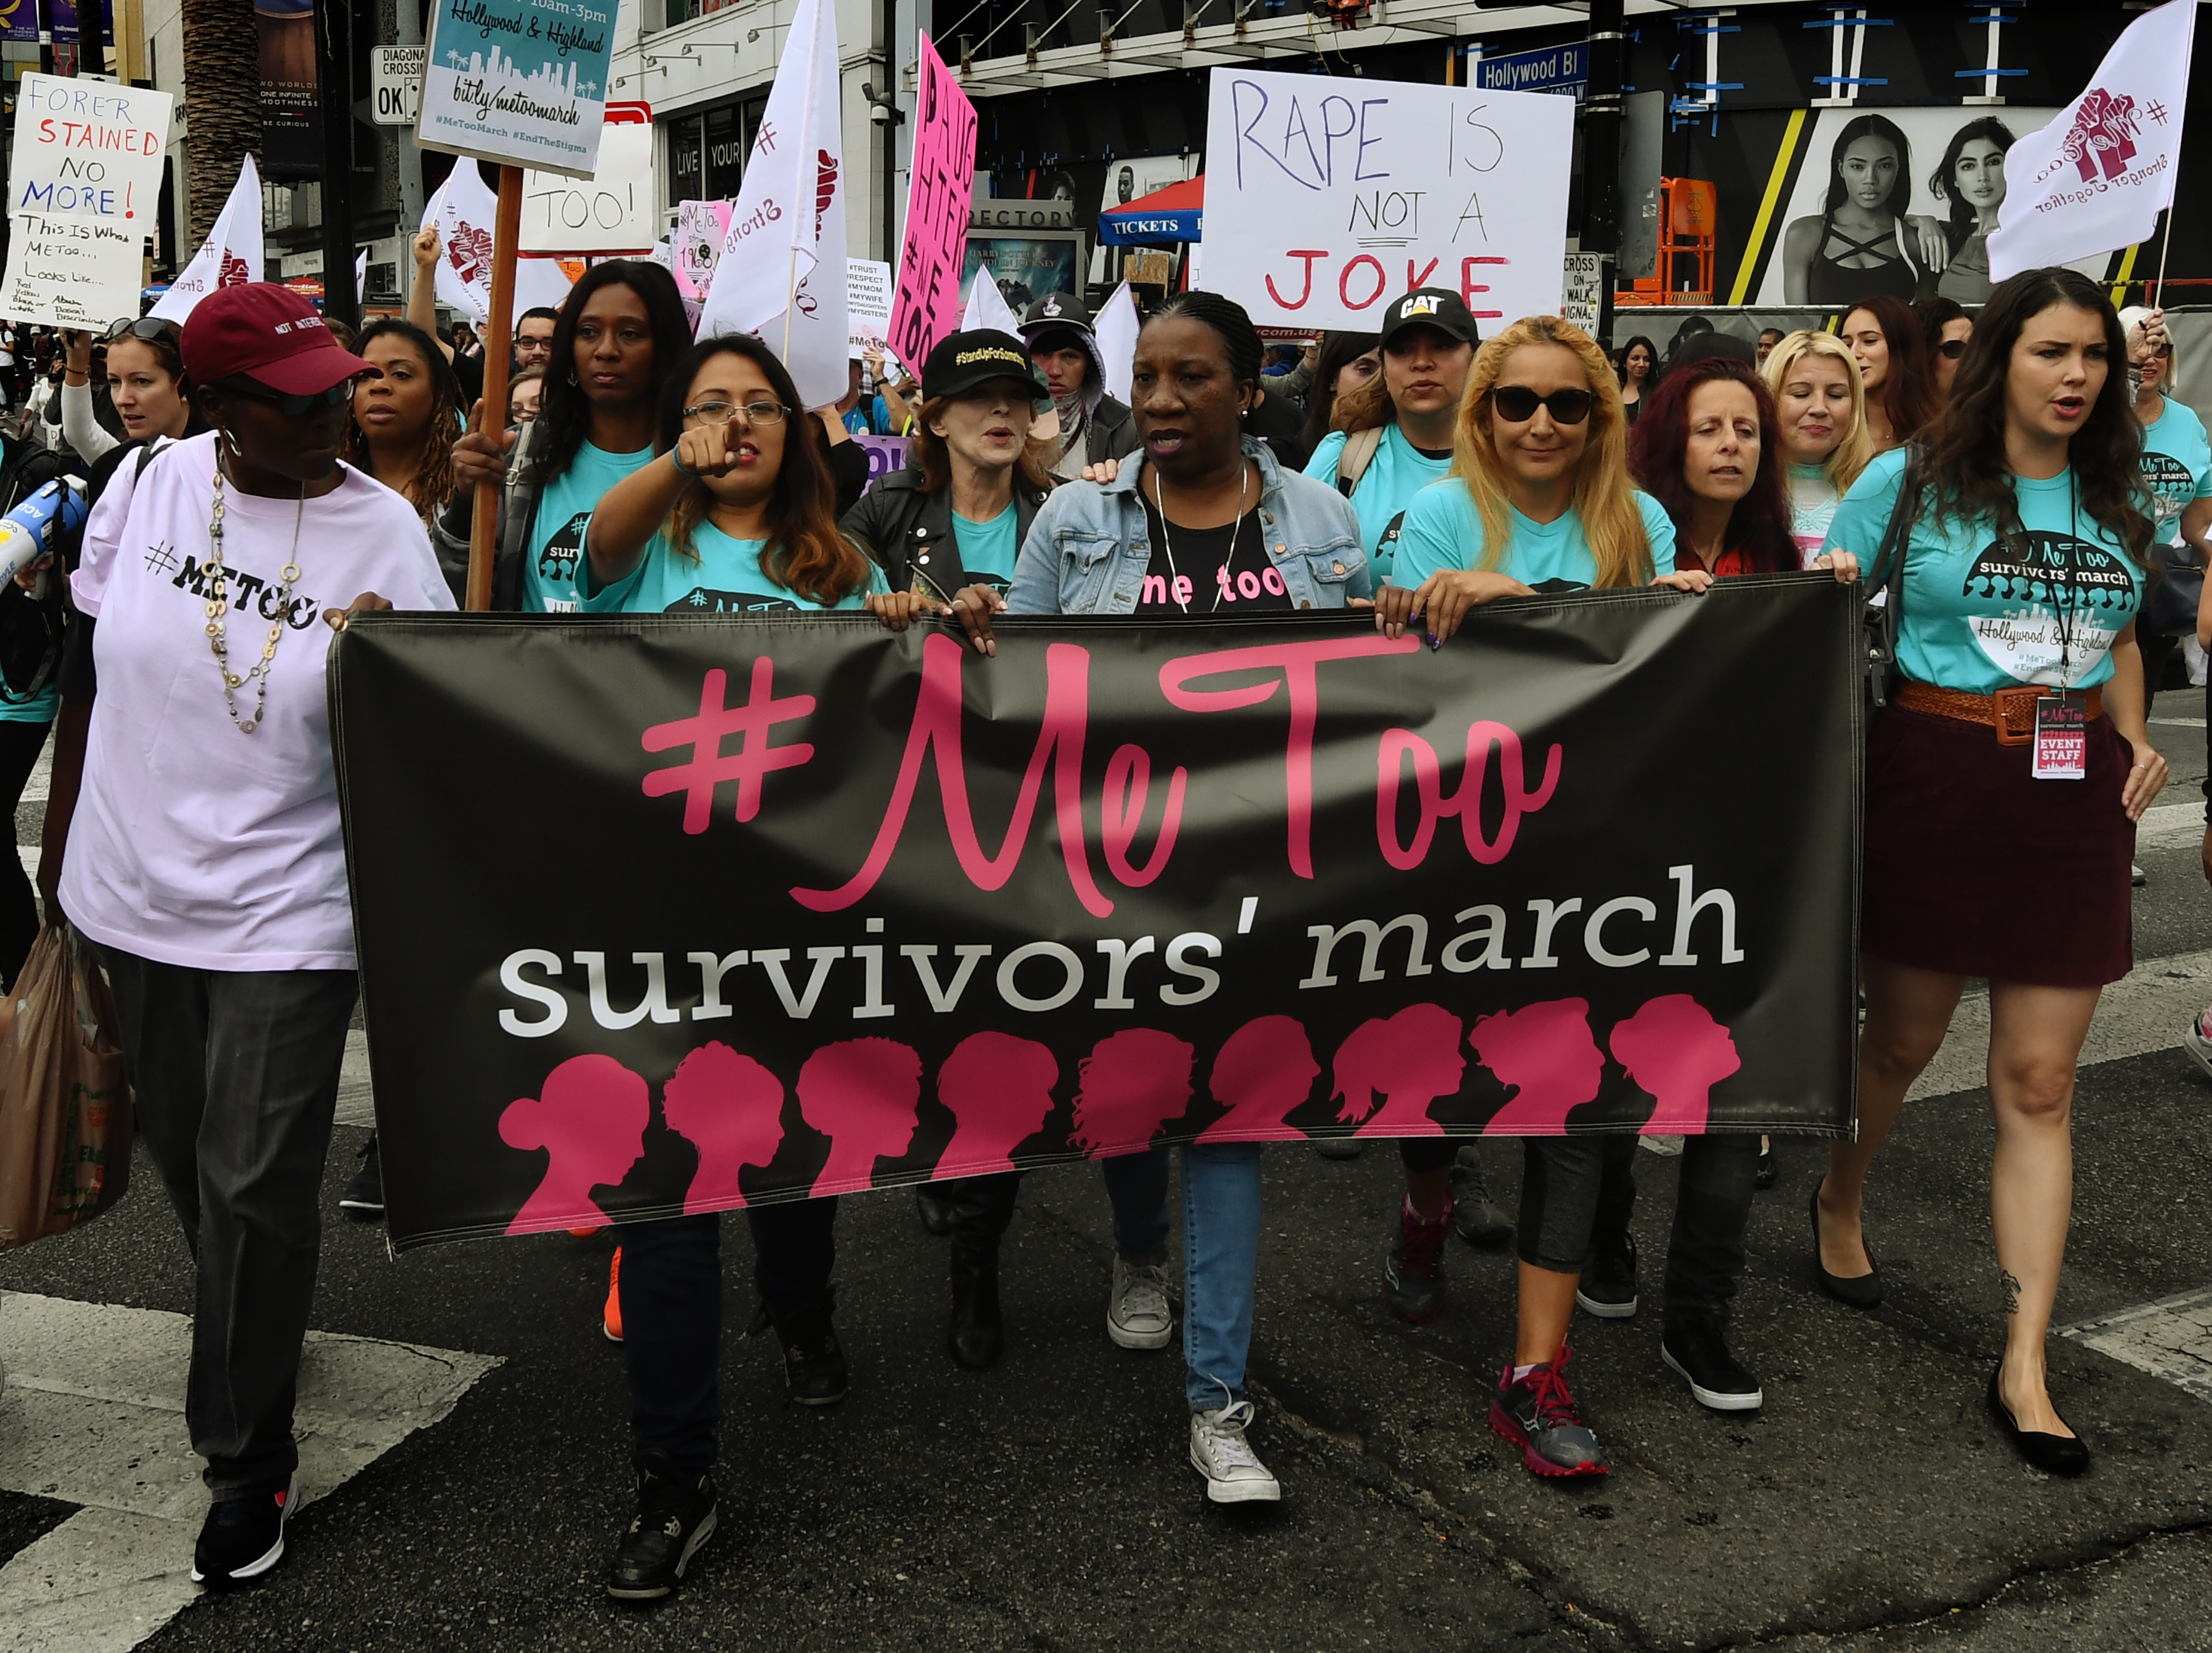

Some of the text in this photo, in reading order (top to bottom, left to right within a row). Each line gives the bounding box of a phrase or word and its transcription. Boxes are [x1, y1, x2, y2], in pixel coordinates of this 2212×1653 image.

[452, 0, 604, 56] Hollywood & Highland
[383, 49, 425, 61] DIAGONA
[1486, 50, 1577, 90] Hollywood Bl
[29, 79, 133, 124] FORER
[379, 87, 403, 115] OK
[453, 75, 580, 125] bit.ly/metoomarch
[1577, 84, 1584, 101] W
[38, 119, 158, 156] STAINED
[436, 115, 587, 154] #MeTooMarch #EndTheStigma
[1232, 79, 1503, 191] RAPE IS
[59, 157, 105, 182] NO
[676, 142, 740, 175] LIVE YOUR
[18, 215, 129, 243] This IS What
[969, 209, 1074, 226] RECTORY
[1112, 219, 1178, 234] TICKETS
[1349, 191, 1487, 243] NOT A
[25, 261, 66, 282] Looks
[1564, 258, 1594, 272] CROSS
[848, 274, 883, 284] RESPECT
[1265, 250, 1511, 318] JOKE
[1574, 275, 1584, 286] ON
[1400, 296, 1441, 319] CAT
[1567, 289, 1590, 303] WALK
[275, 322, 292, 334] NOT
[1142, 563, 1285, 604] me too
[2076, 570, 2129, 586] march
[1978, 620, 2045, 651] Hollywood
[2040, 739, 2083, 749] EVENT
[2041, 750, 2080, 760] STAFF
[499, 864, 1744, 1037] survivors' march
